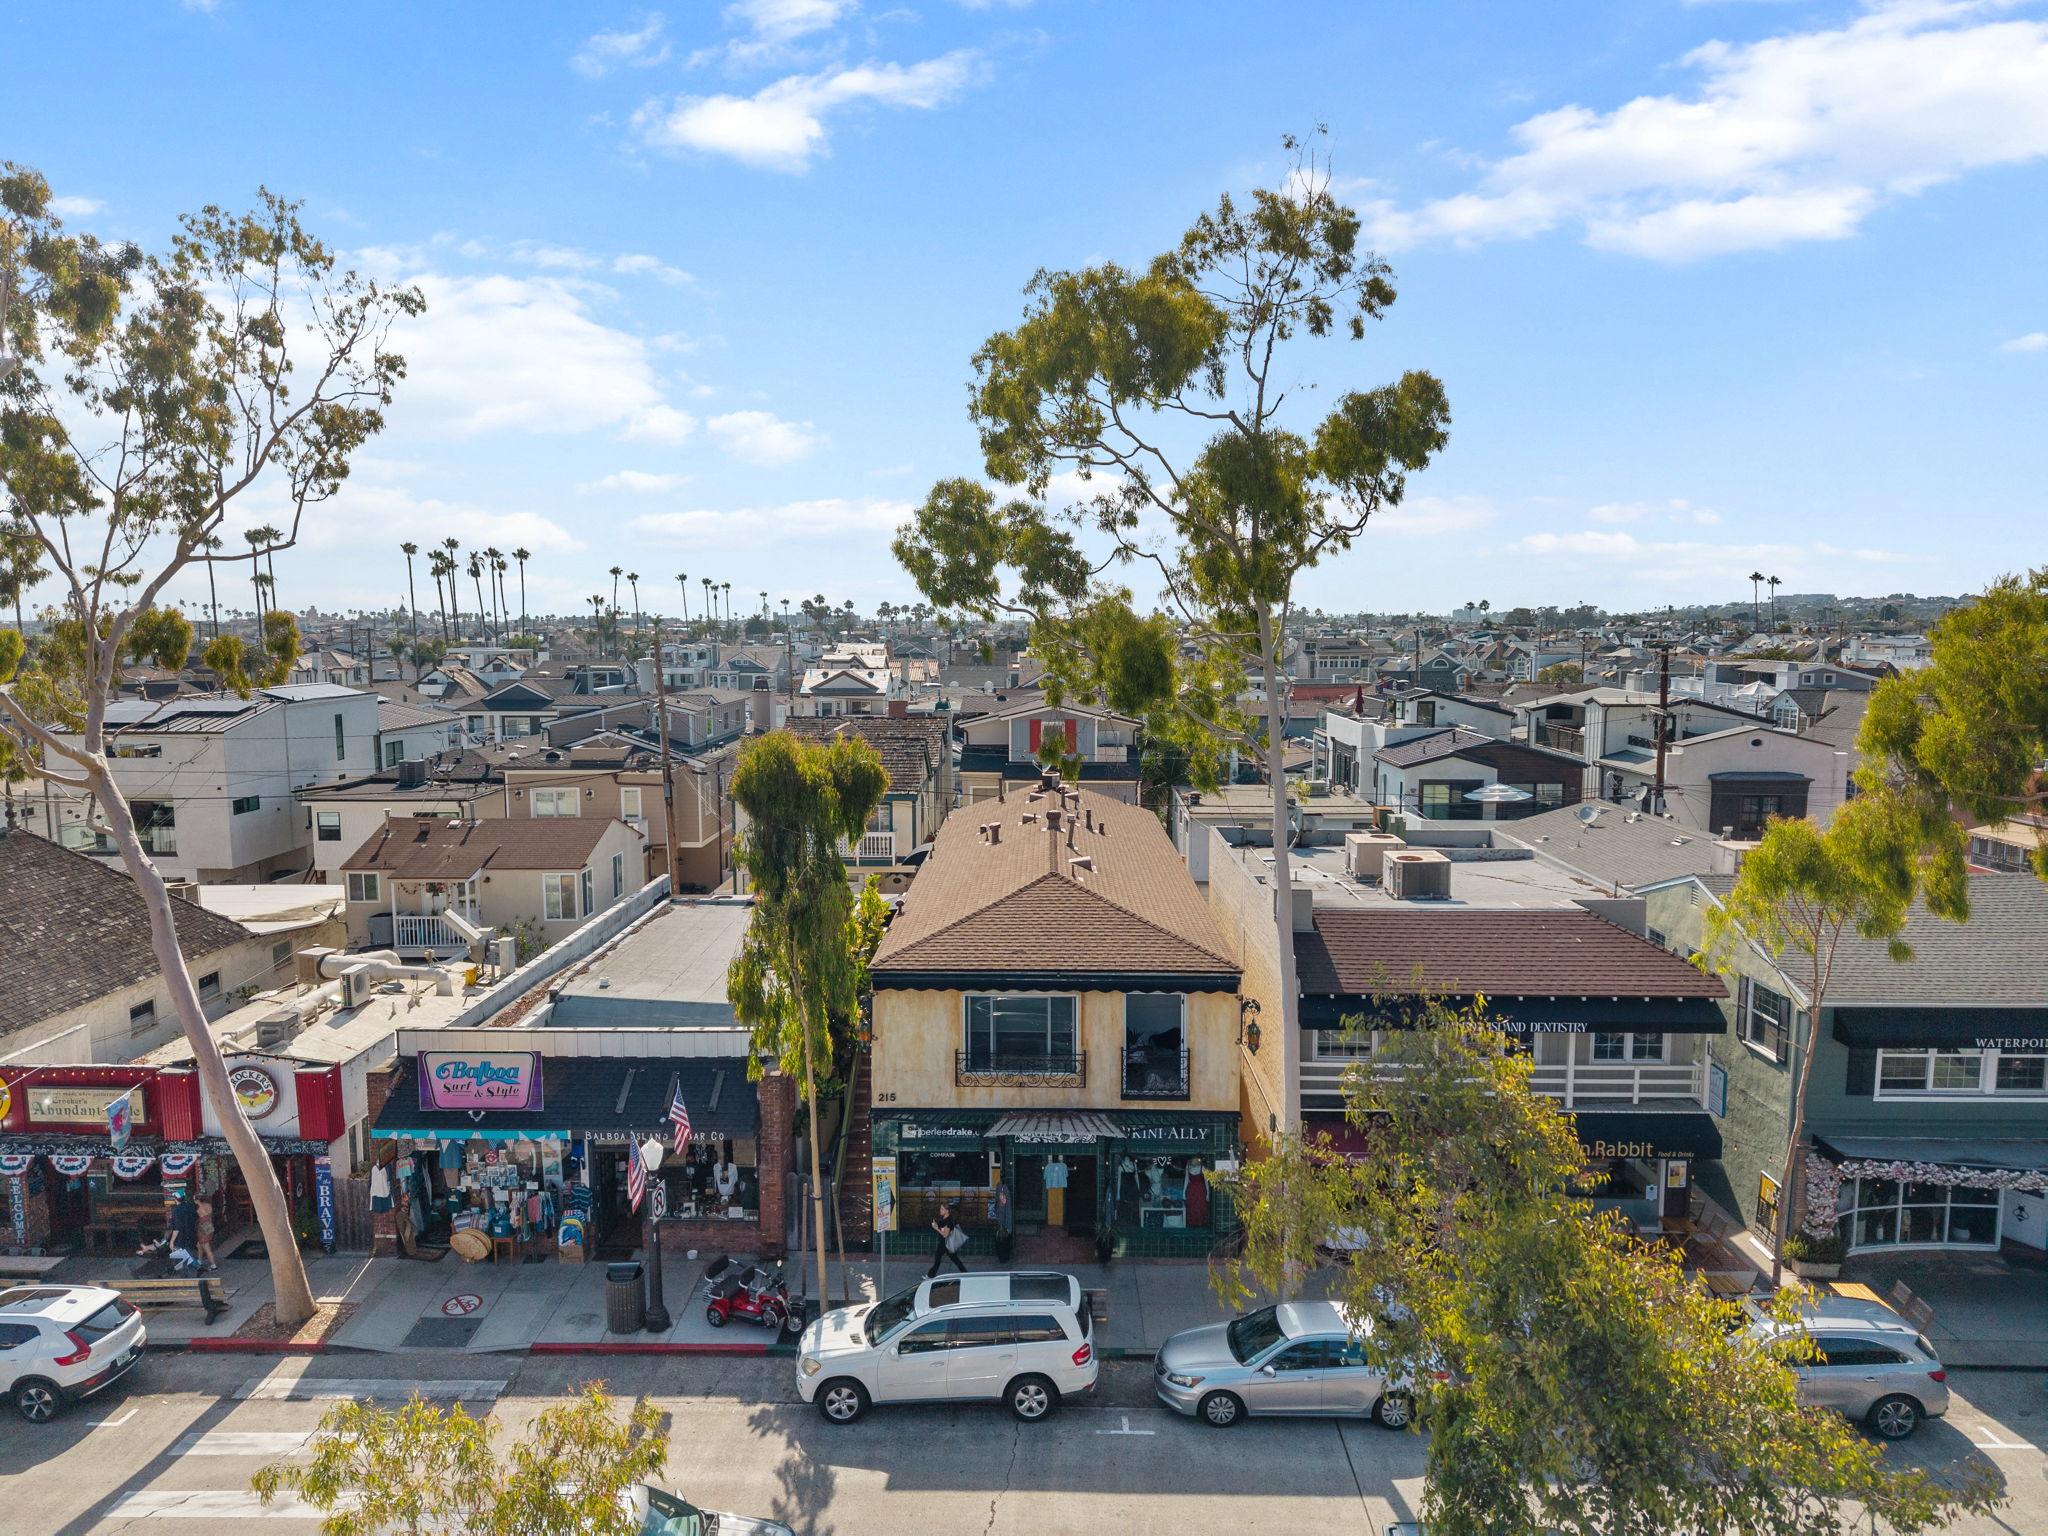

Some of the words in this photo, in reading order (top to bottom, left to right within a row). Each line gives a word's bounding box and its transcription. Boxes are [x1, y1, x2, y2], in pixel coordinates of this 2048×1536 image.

[1488, 1022, 1526, 1033] ISLAND
[1530, 1022, 1588, 1033] DENTISTRY
[230, 1071, 272, 1089] ROCKER'S
[435, 1061, 521, 1087] Balboa
[443, 1081, 472, 1093] Surf
[486, 1085, 520, 1099] Style
[878, 1093, 896, 1102] 215
[32, 1101, 102, 1118] Abundant
[585, 1131, 626, 1141] BALBOA
[636, 1132, 670, 1141] SLAND
[1167, 1127, 1208, 1140] ALLY
[1594, 1140, 1655, 1158] Rabbit
[10, 1177, 26, 1239] WELCOME
[319, 1185, 334, 1240] BRAVE
